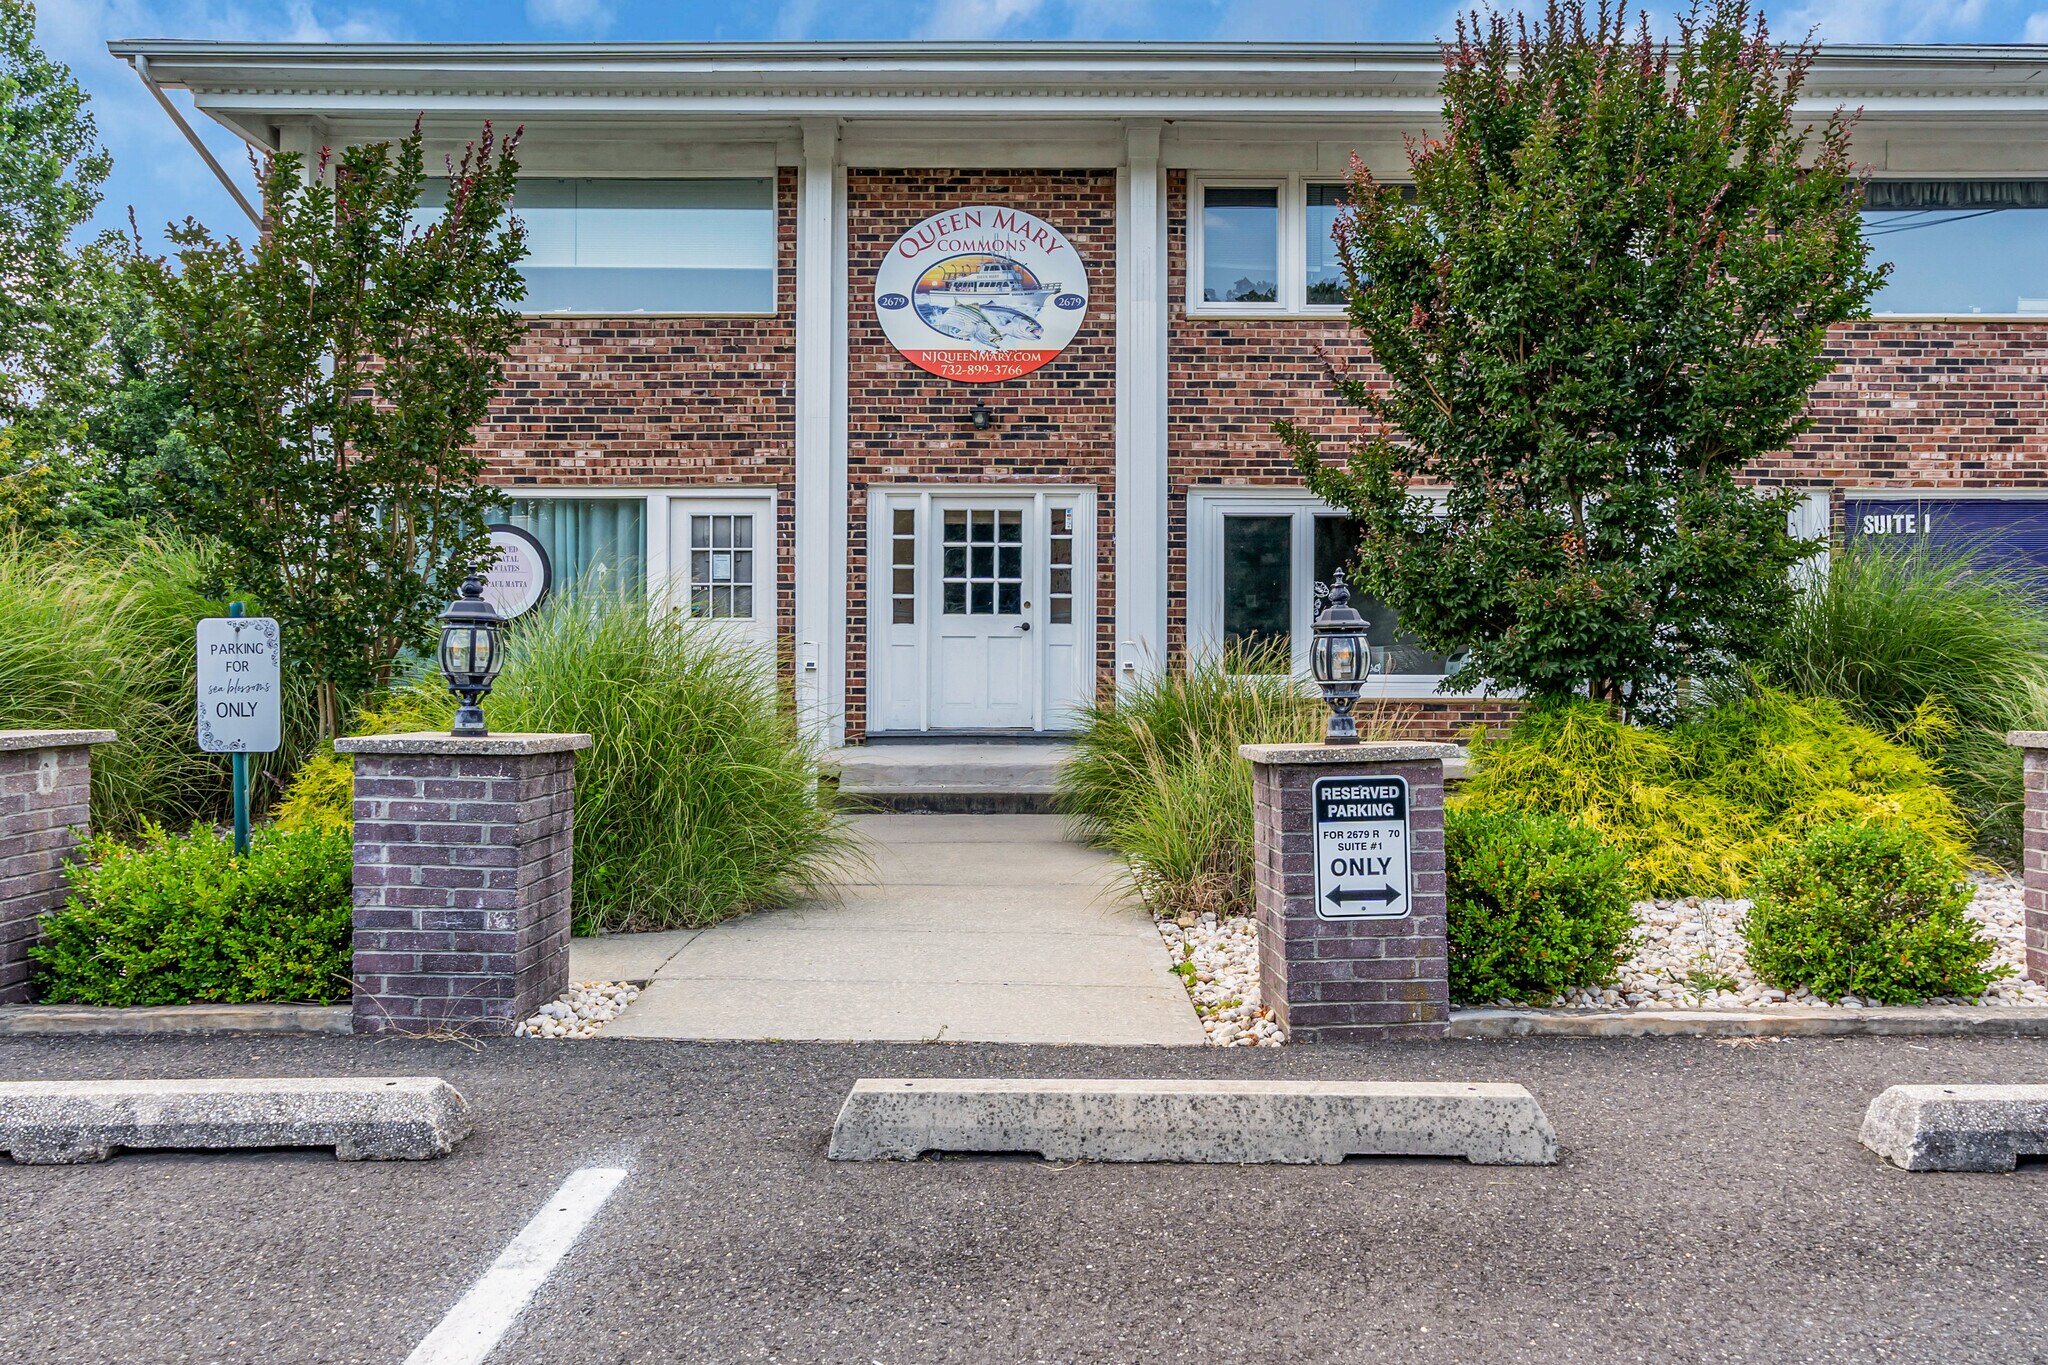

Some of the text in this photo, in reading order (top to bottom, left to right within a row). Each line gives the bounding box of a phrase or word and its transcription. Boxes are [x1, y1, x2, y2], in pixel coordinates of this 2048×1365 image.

[899, 209, 1064, 259] QUEEN MARY
[937, 239, 1026, 252] COMMONS
[882, 297, 905, 307] 2679
[1059, 297, 1082, 307] 2679
[941, 364, 1023, 376] 732-899-3766
[1863, 514, 1916, 534] SUITE
[211, 642, 264, 655] PARKING
[226, 661, 249, 672] FOR
[216, 702, 258, 718] ONLY
[1321, 786, 1400, 800] RESERVED
[1328, 803, 1394, 818] PARKING
[1324, 831, 1344, 840] FOR
[1347, 830, 1370, 839] 2679
[1389, 829, 1400, 838] 70
[1338, 842, 1383, 851] SUITE #1
[1331, 857, 1392, 877] ONLY
